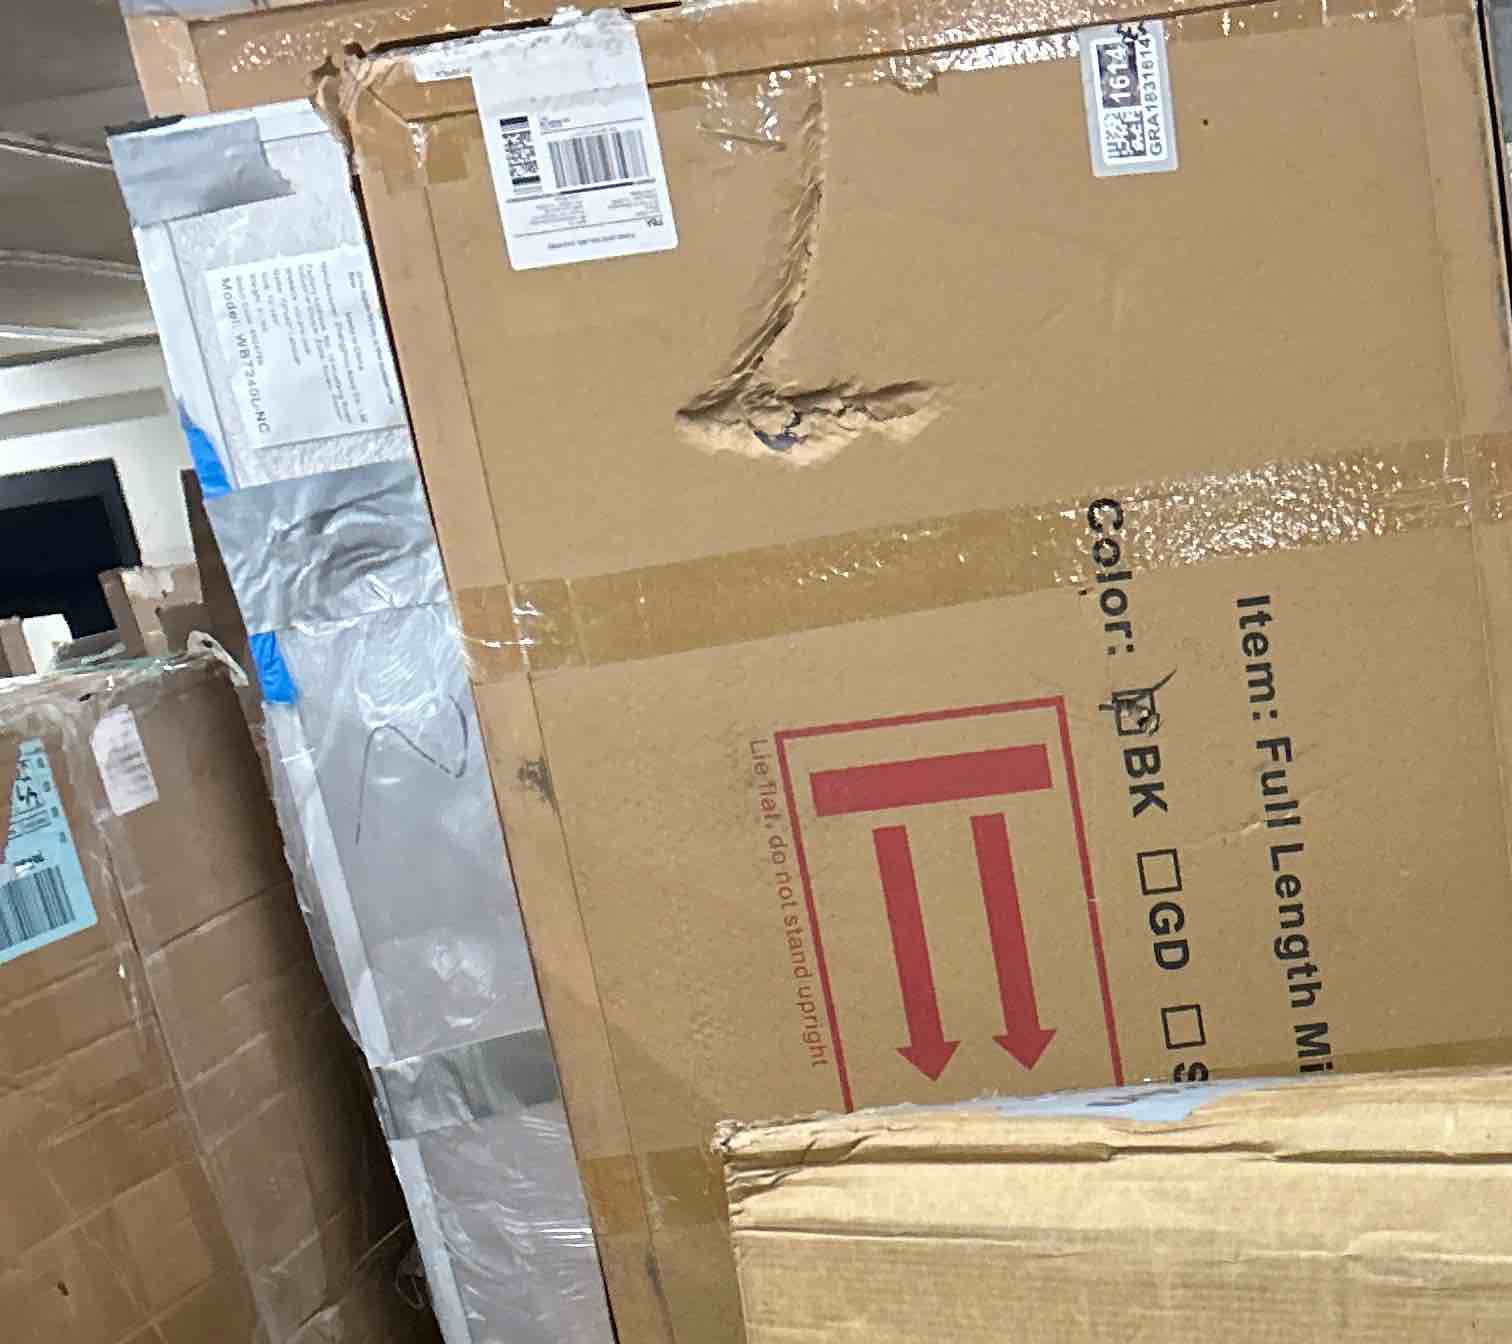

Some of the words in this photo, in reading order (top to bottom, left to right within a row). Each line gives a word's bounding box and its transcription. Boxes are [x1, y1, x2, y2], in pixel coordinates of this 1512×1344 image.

[1104, 44, 1132, 104] 1614
[1236, 594, 1279, 722] Item:
[750, 738, 769, 776] Lie
[1087, 497, 1135, 656] Color:
[1124, 745, 1169, 818] BK
[1148, 900, 1191, 971] GD
[1255, 736, 1302, 829] Full
[768, 834, 788, 865] do
[775, 871, 798, 909] not
[1269, 841, 1323, 1008] Length
[783, 909, 814, 981] stand
[796, 983, 829, 1068] upright
